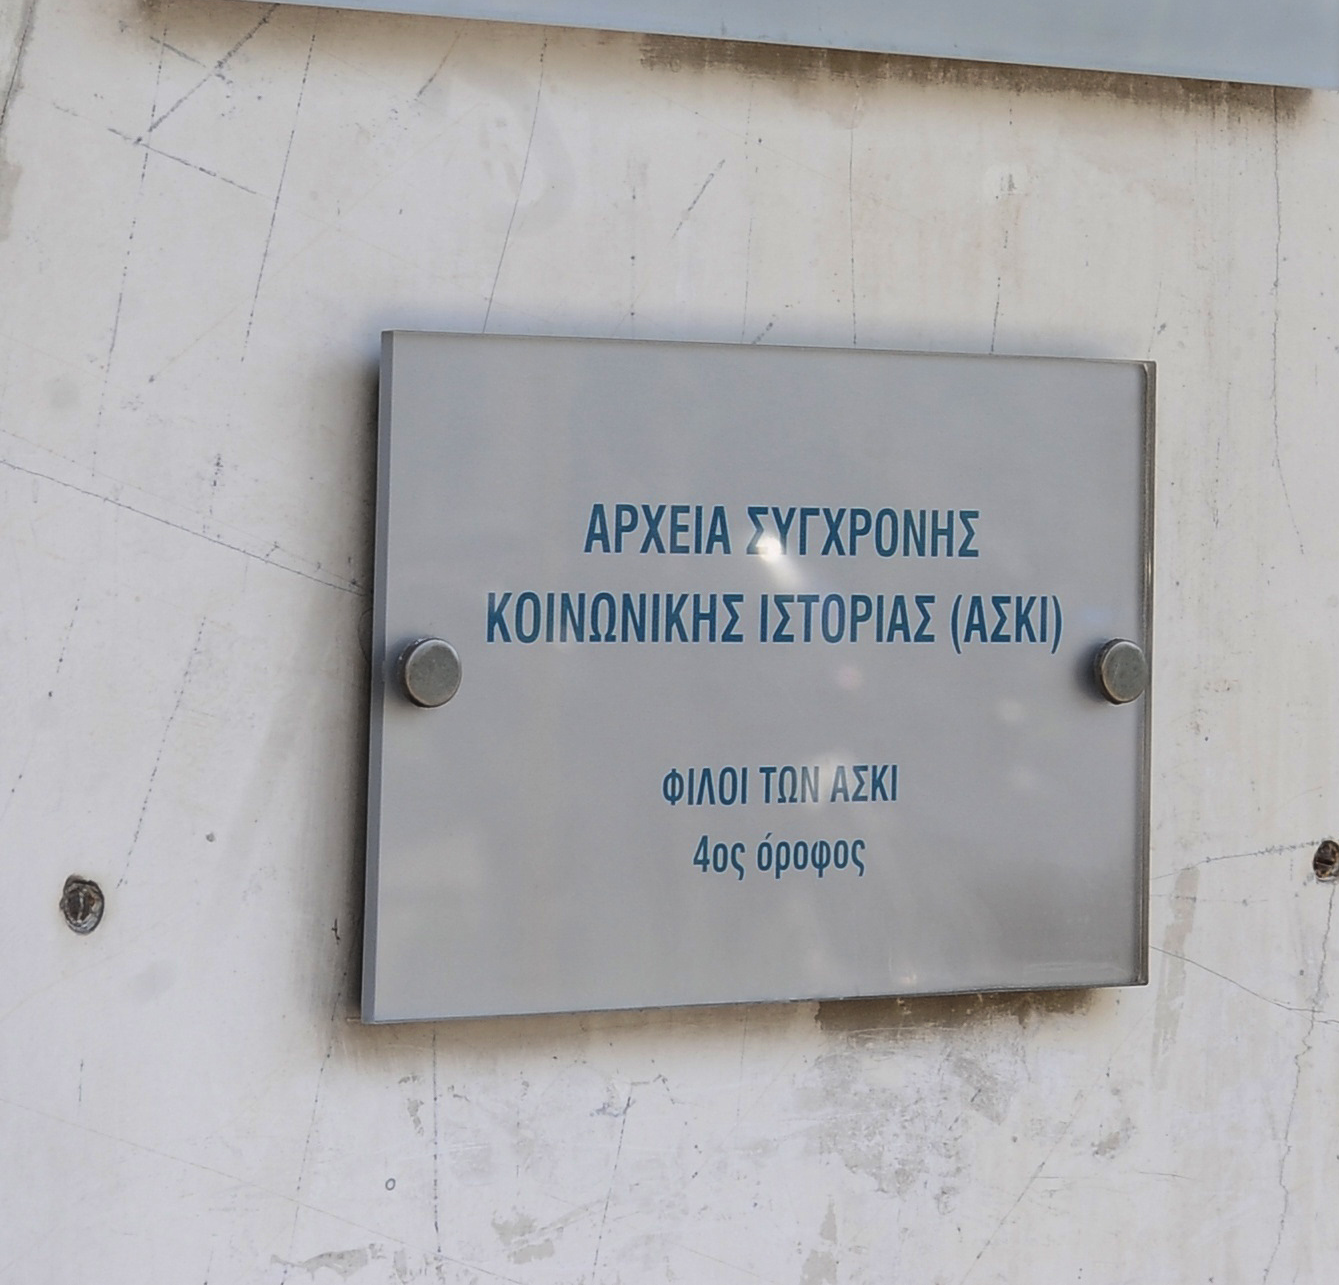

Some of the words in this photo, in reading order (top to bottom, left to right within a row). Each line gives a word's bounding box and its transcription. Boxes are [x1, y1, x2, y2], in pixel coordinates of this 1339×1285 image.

[584, 503, 731, 555] ΑΡΧΕΙΑ
[746, 506, 980, 558] ΣΥΓΧΡΟΝΗΣ
[486, 592, 744, 643] ΚΟΙΝΩΝΙΚΗΣ
[759, 593, 936, 644] ΙΣΤΟΡΙΑΣ
[950, 594, 1063, 654] (ΑΣΚΙ)
[662, 767, 747, 806] ΦΙΛΟΙ
[760, 766, 820, 804] ΤΩΝ
[830, 764, 898, 802] ΑΣΚΙ
[692, 835, 745, 879] 4ος
[756, 832, 866, 879] όροφος
